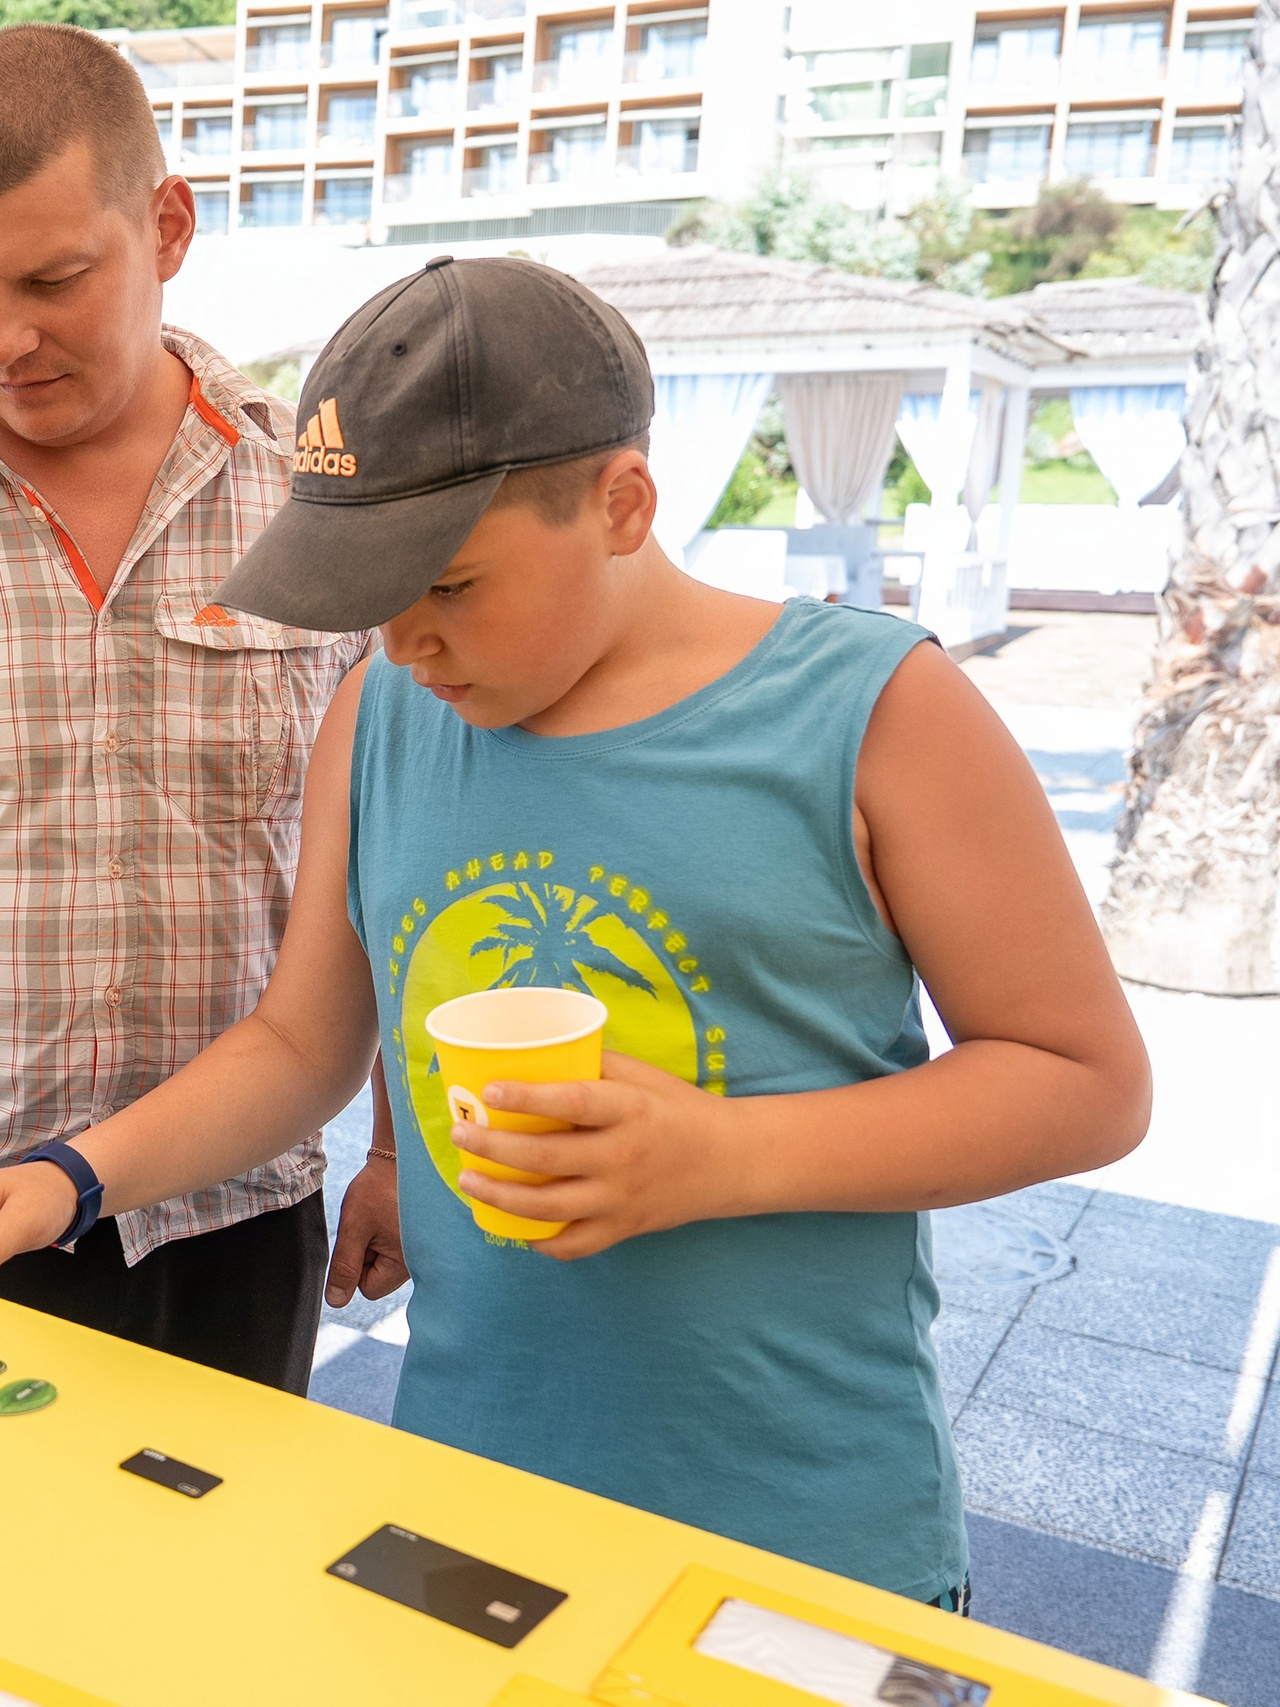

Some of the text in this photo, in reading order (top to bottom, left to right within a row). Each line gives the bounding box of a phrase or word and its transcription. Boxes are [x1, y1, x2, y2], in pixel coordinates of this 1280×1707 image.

[292, 445, 357, 477] adidas
[446, 850, 553, 892] AHEAD
[589, 865, 710, 992] PERFECT
[459, 1105, 469, 1120] T
